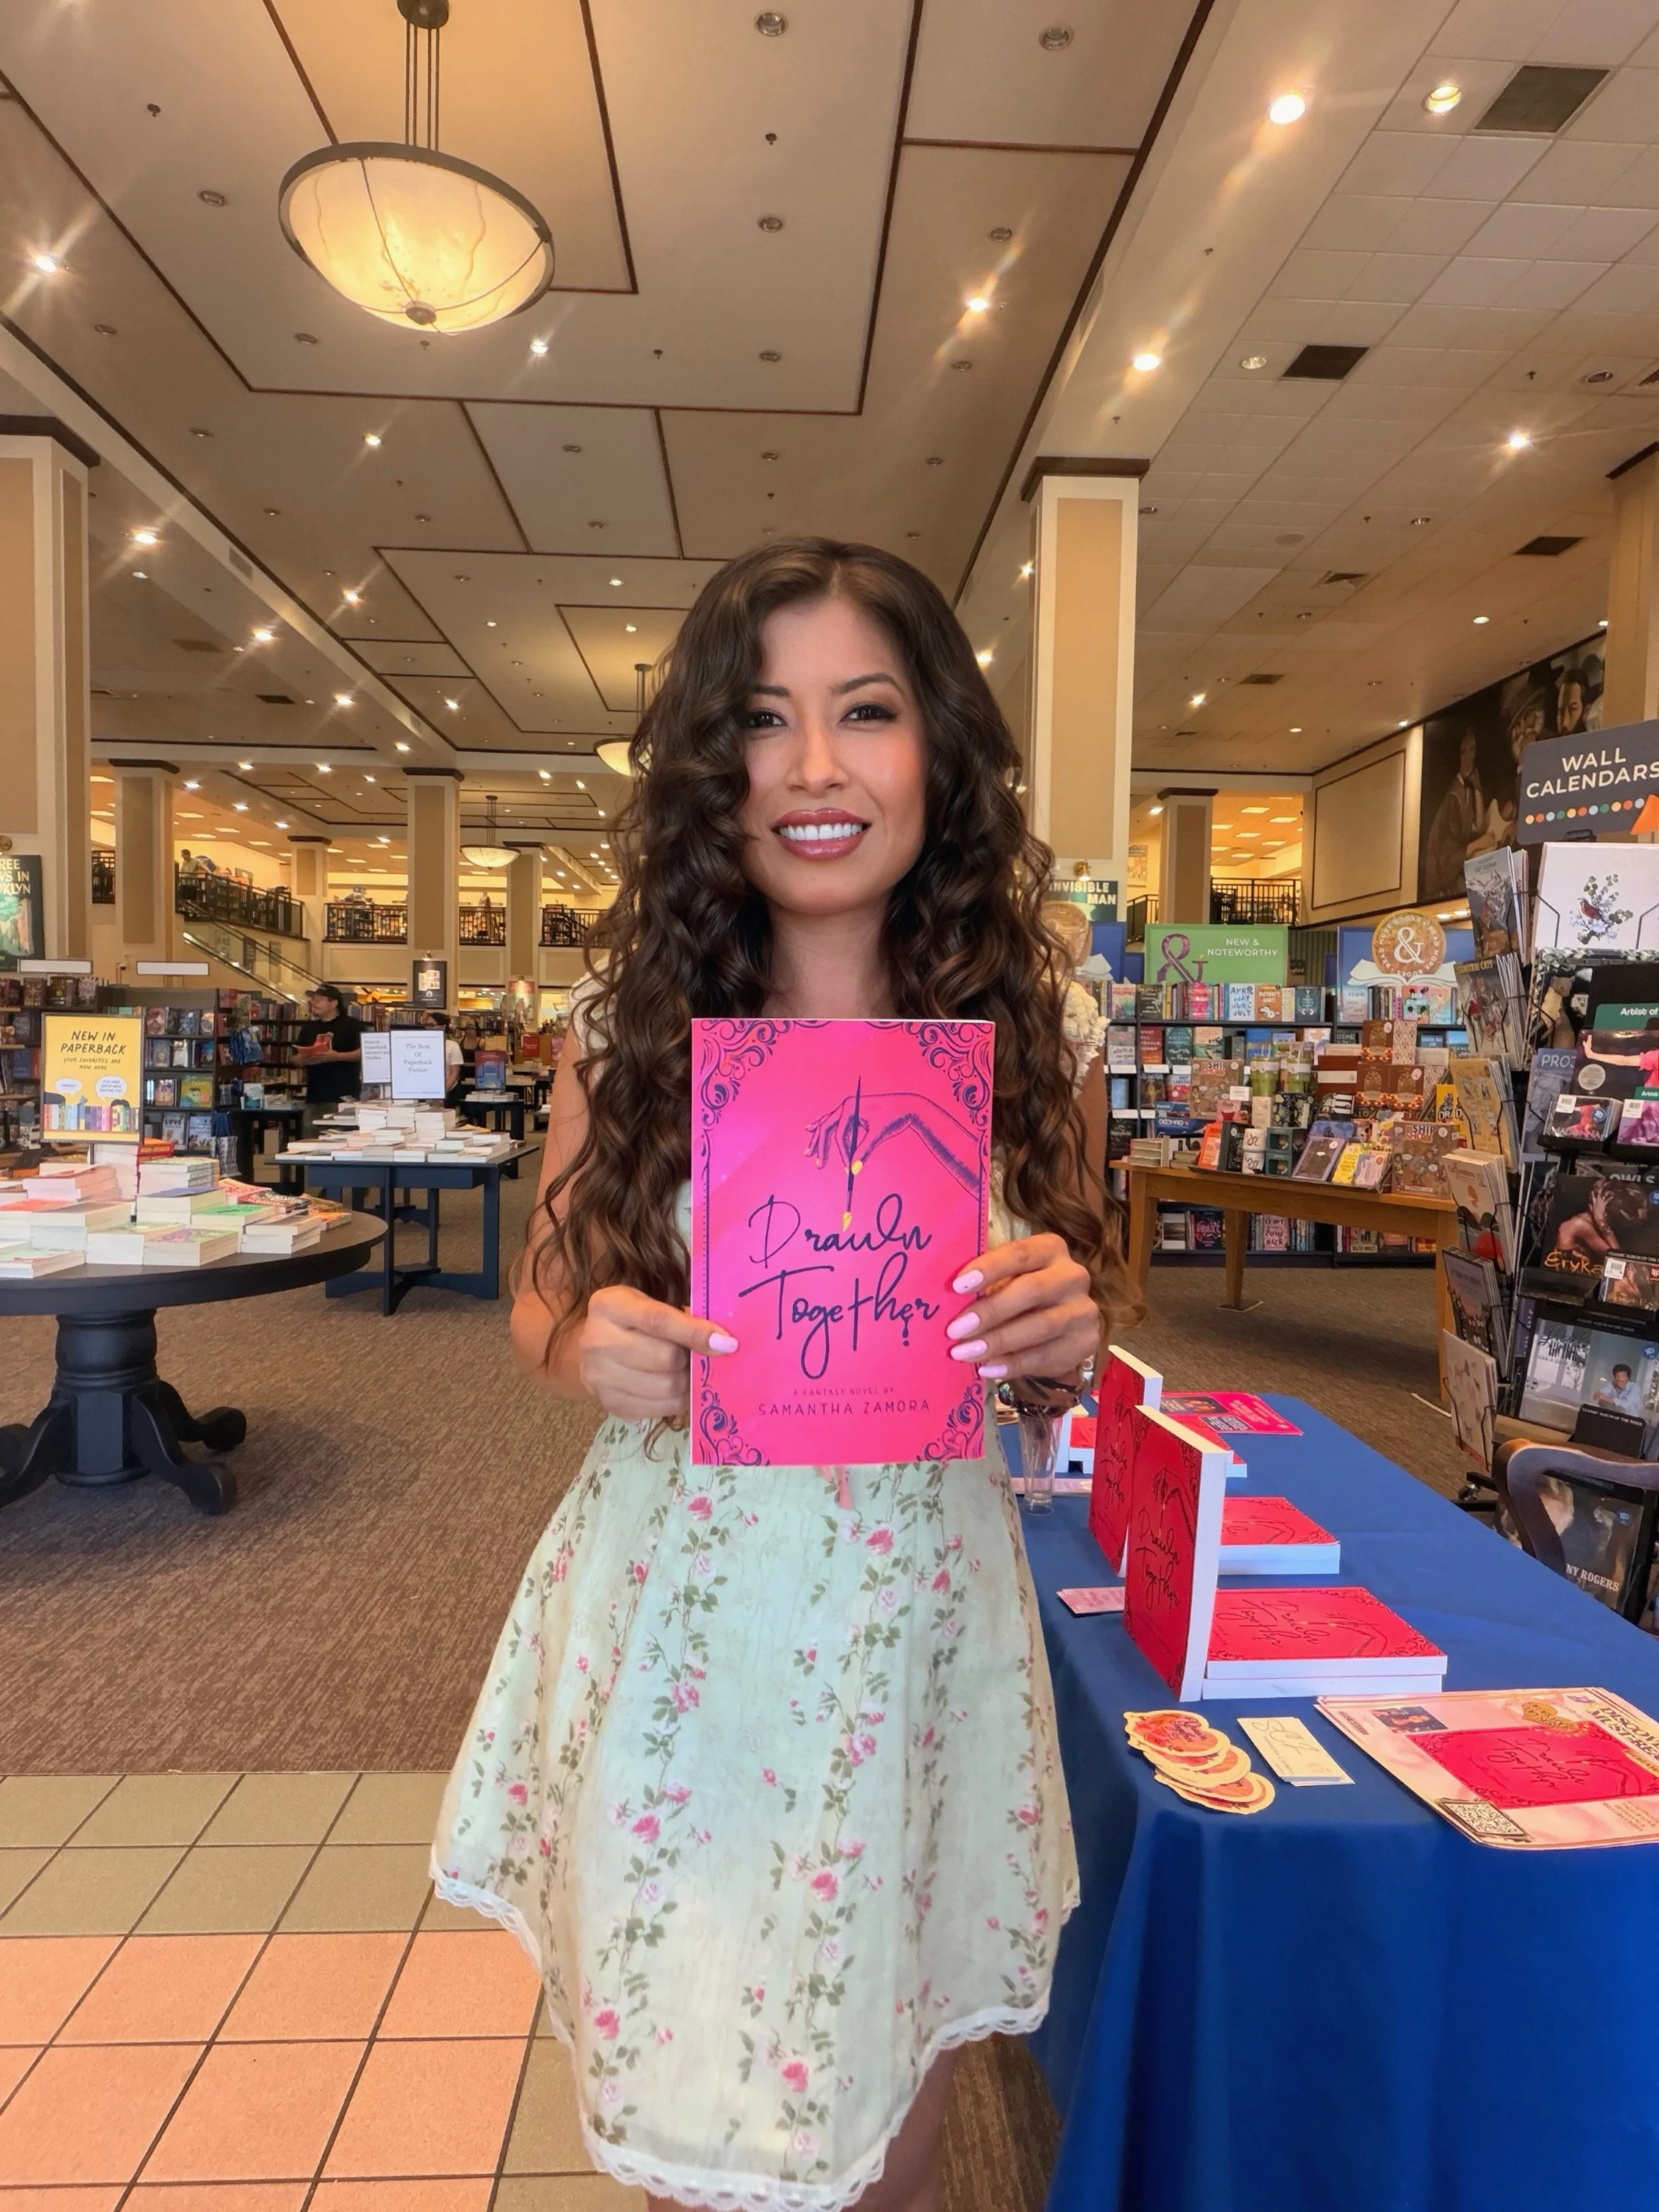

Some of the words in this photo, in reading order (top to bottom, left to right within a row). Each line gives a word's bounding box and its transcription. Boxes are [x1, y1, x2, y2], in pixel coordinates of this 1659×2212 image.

[1561, 747, 1626, 773] WALL
[1526, 761, 1659, 798] CALENDARS
[17, 870, 29, 882] IN
[1087, 893, 1116, 905] MAN
[1480, 959, 1494, 970] CATS
[71, 1030, 98, 1041] NEW
[102, 1032, 116, 1041] IN
[60, 1043, 127, 1055] PAPERBACK
[1413, 1125, 1436, 1134] SHIP
[749, 1193, 932, 1268] Drawn
[738, 1251, 940, 1380] Together
[758, 1401, 853, 1416] SAMANTHA
[864, 1399, 929, 1414] ZAMORA
[1580, 1569, 1619, 1591] ROGERS
